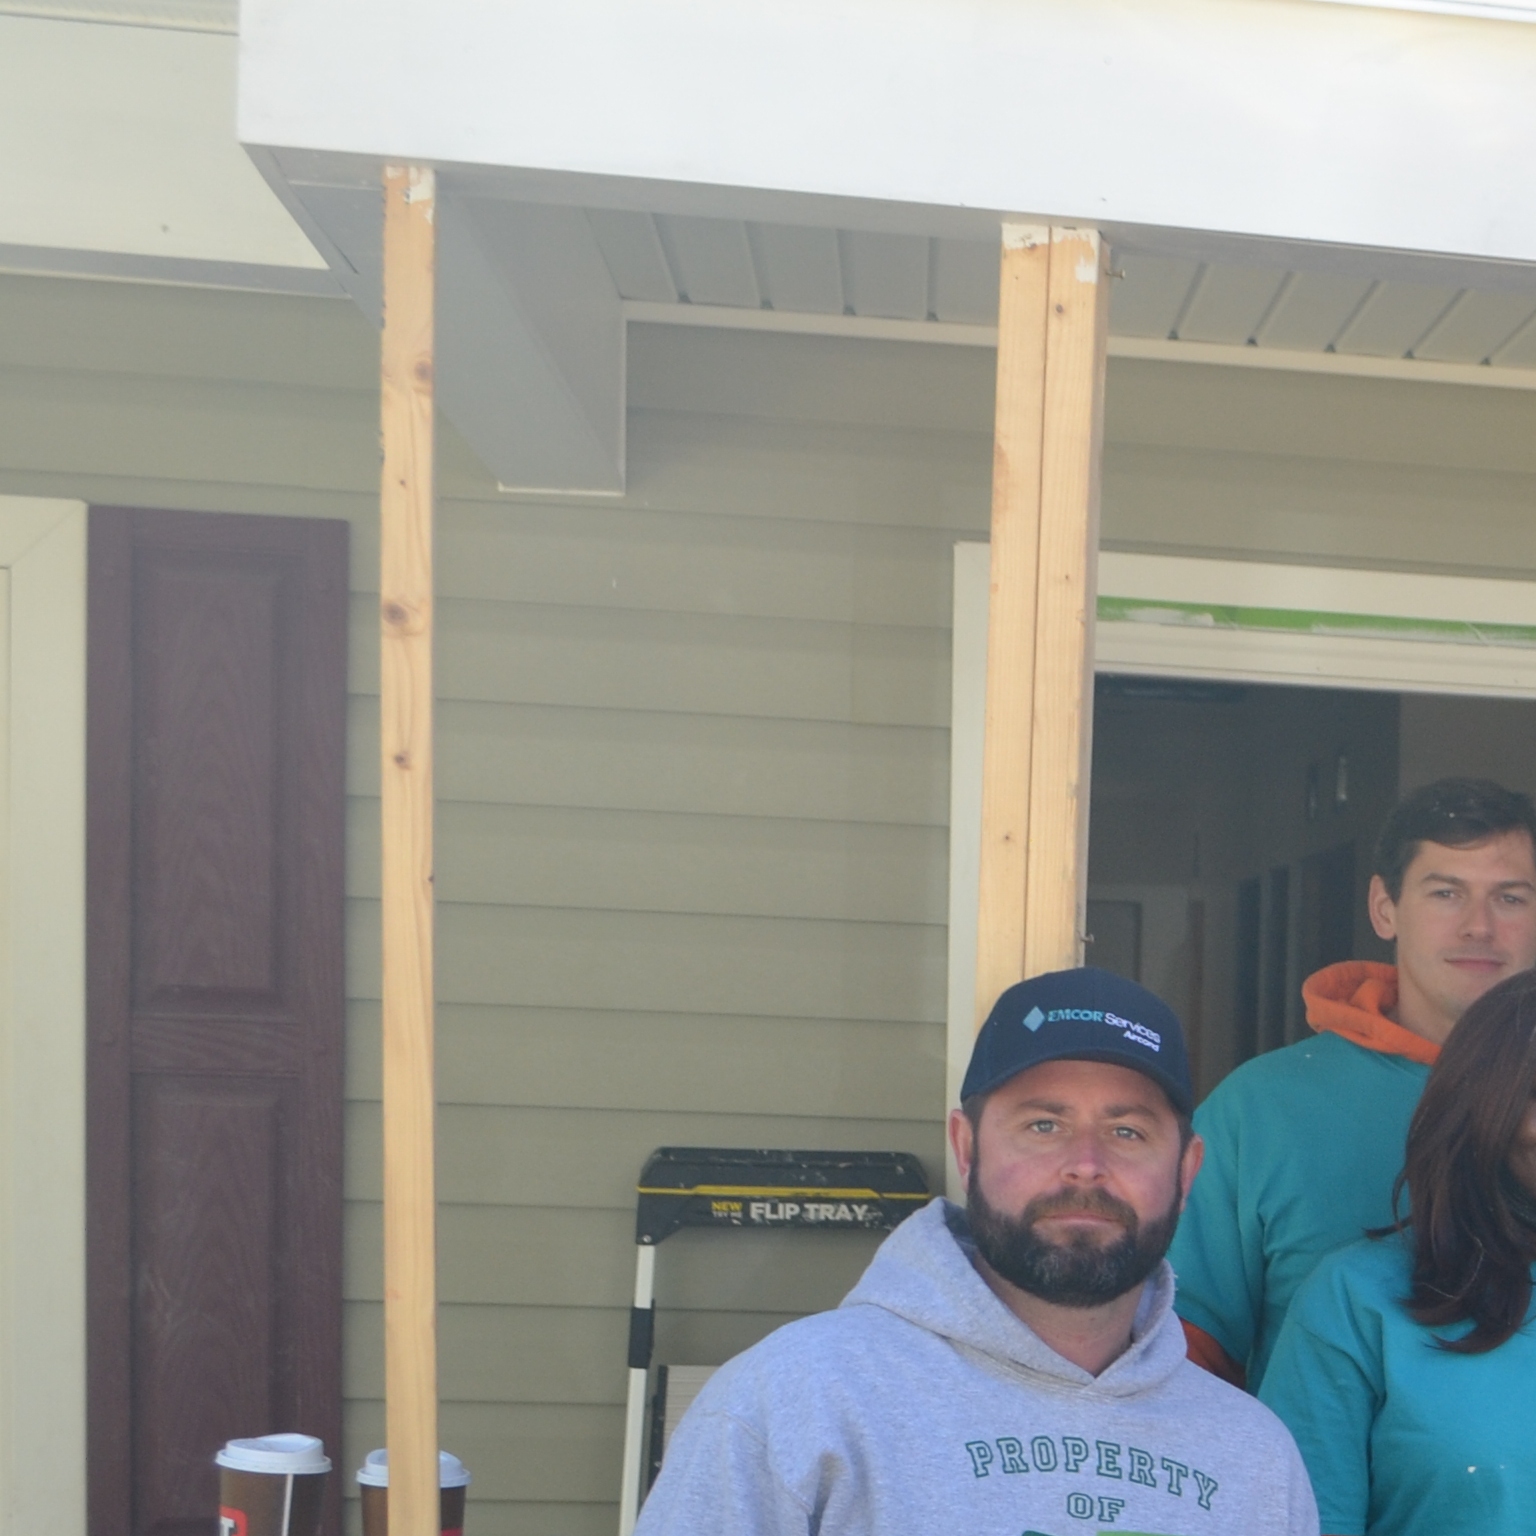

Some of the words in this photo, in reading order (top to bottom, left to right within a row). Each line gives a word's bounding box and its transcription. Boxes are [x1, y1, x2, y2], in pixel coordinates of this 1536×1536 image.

[1047, 1008, 1104, 1022] EMCOR
[1104, 1012, 1162, 1044] Services
[1123, 1030, 1161, 1053] Aircond
[711, 1200, 743, 1212] NEW
[749, 1202, 800, 1221] FLIP
[802, 1203, 869, 1222] TRAY
[965, 1435, 1219, 1512] PROPERTY
[1066, 1492, 1126, 1523] OF
